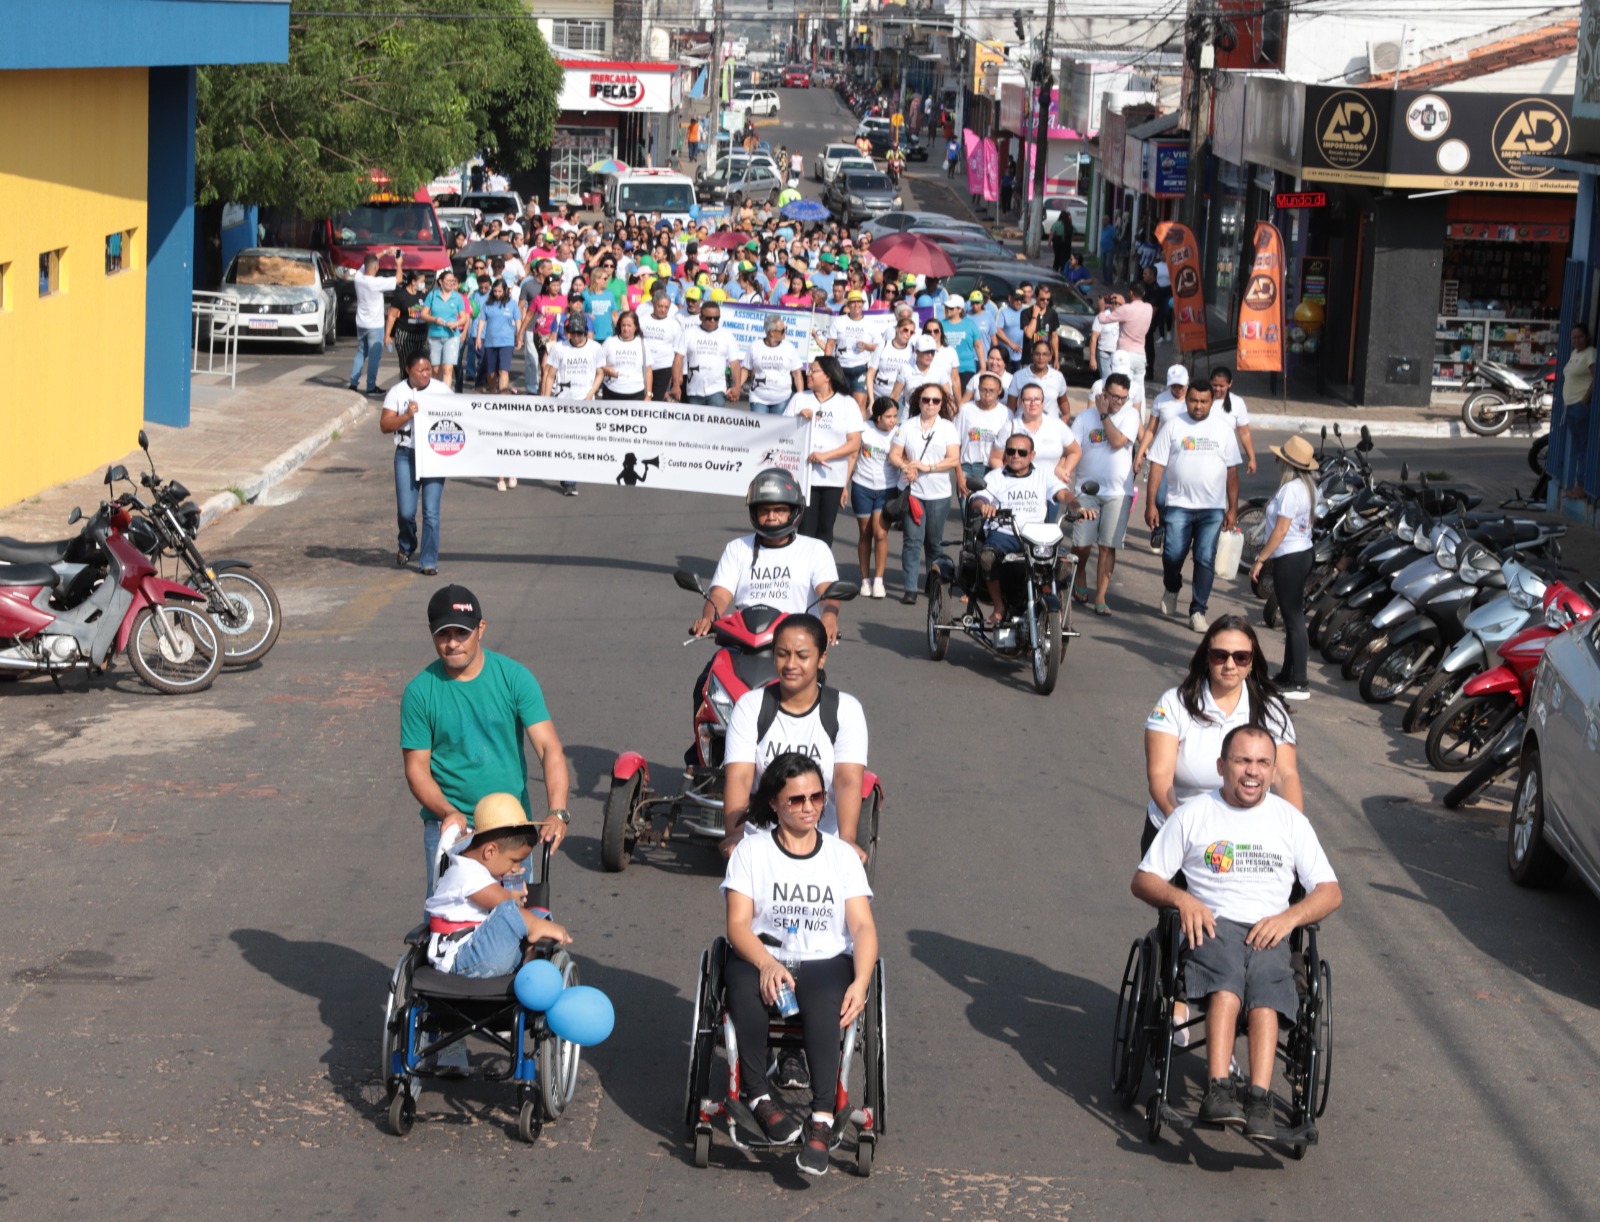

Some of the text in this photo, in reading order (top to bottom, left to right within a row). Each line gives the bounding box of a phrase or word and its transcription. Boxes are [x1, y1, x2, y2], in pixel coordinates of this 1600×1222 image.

[594, 84, 637, 100] PEÇAS
[1322, 102, 1371, 143] AD
[1501, 110, 1562, 152] AD
[1322, 141, 1368, 151] IMPORTADORA
[483, 402, 533, 413] CAMINHA
[534, 405, 554, 413] DAS
[556, 405, 602, 415] PESSOAS
[604, 407, 629, 417] COM
[631, 408, 691, 421] DEFICIÊNCIA
[692, 414, 705, 422] DE
[706, 416, 761, 428] ARAGUAÍNA
[477, 429, 503, 437] Semana
[504, 430, 535, 439] Municipal
[595, 422, 648, 434] 5º SMPCD
[496, 448, 618, 462] NADA SOBRE NÓS, SEM NÓS.
[668, 459, 687, 468] Custa
[704, 460, 743, 472] Ouvir?
[1007, 490, 1038, 500] NADA
[750, 566, 791, 580] NADA
[750, 582, 773, 590] SOBRE
[750, 591, 767, 600] SEM
[1235, 851, 1283, 861] INTERNACIONAL
[1235, 865, 1274, 873] DEFICIÊNCIA
[1245, 859, 1271, 867] PESSOA
[772, 882, 835, 905] NADA
[772, 904, 834, 919] SOBRE NÓS,
[773, 917, 800, 929] SEM
